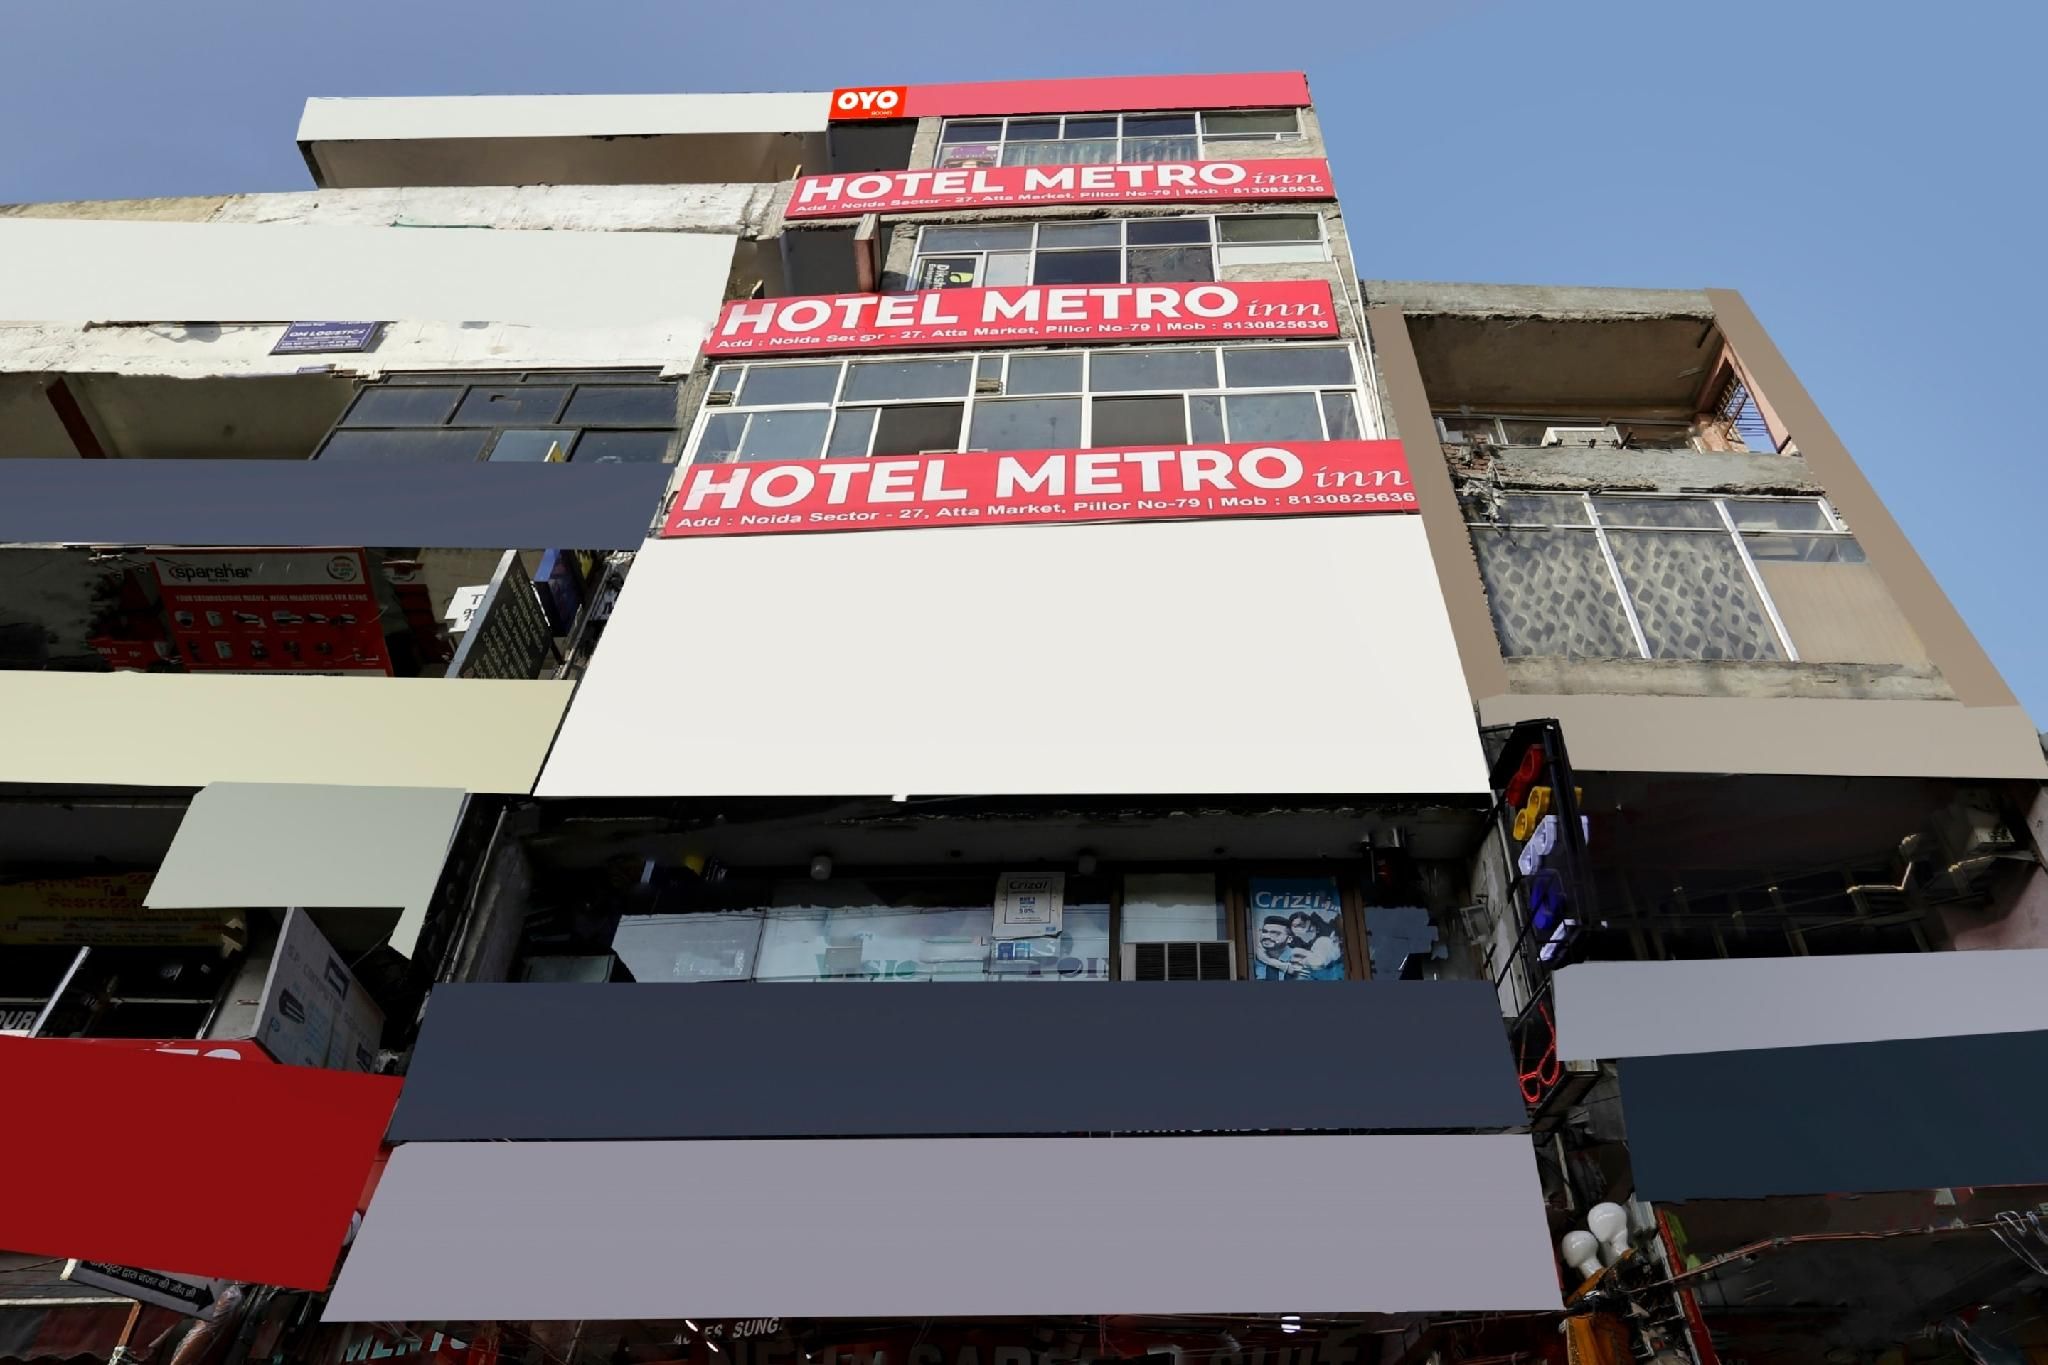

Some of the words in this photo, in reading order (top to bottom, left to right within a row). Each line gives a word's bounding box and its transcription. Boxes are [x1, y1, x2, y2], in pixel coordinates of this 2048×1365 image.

[837, 90, 899, 110] OYO
[795, 204, 827, 212] Add
[841, 200, 886, 209] Noida
[890, 198, 941, 206] Sector
[1184, 187, 1219, 195] Mob
[798, 170, 1005, 204] HOTEL
[1024, 162, 1247, 192] METRO
[1251, 171, 1324, 185] inn
[721, 295, 959, 337] HOTEL
[981, 286, 1239, 323] METRO
[1247, 299, 1326, 317] inn
[717, 338, 754, 349] Add
[769, 335, 821, 346] Noida
[931, 329, 968, 337] Atta
[1098, 323, 1151, 332] No-79
[1166, 322, 1206, 331] Mob
[1222, 320, 1329, 330] 8130825636
[683, 459, 968, 511] HOTEL
[995, 447, 1304, 499] METRO
[1312, 466, 1409, 488] inn
[676, 516, 721, 529] Add
[741, 513, 802, 525] Noida
[809, 511, 880, 522] Sector
[935, 507, 980, 517] Atta
[1073, 501, 1132, 512] Pillor
[1137, 497, 1201, 510] No-79
[1220, 496, 1267, 507] Mob
[1288, 492, 1415, 505] 8130825636
